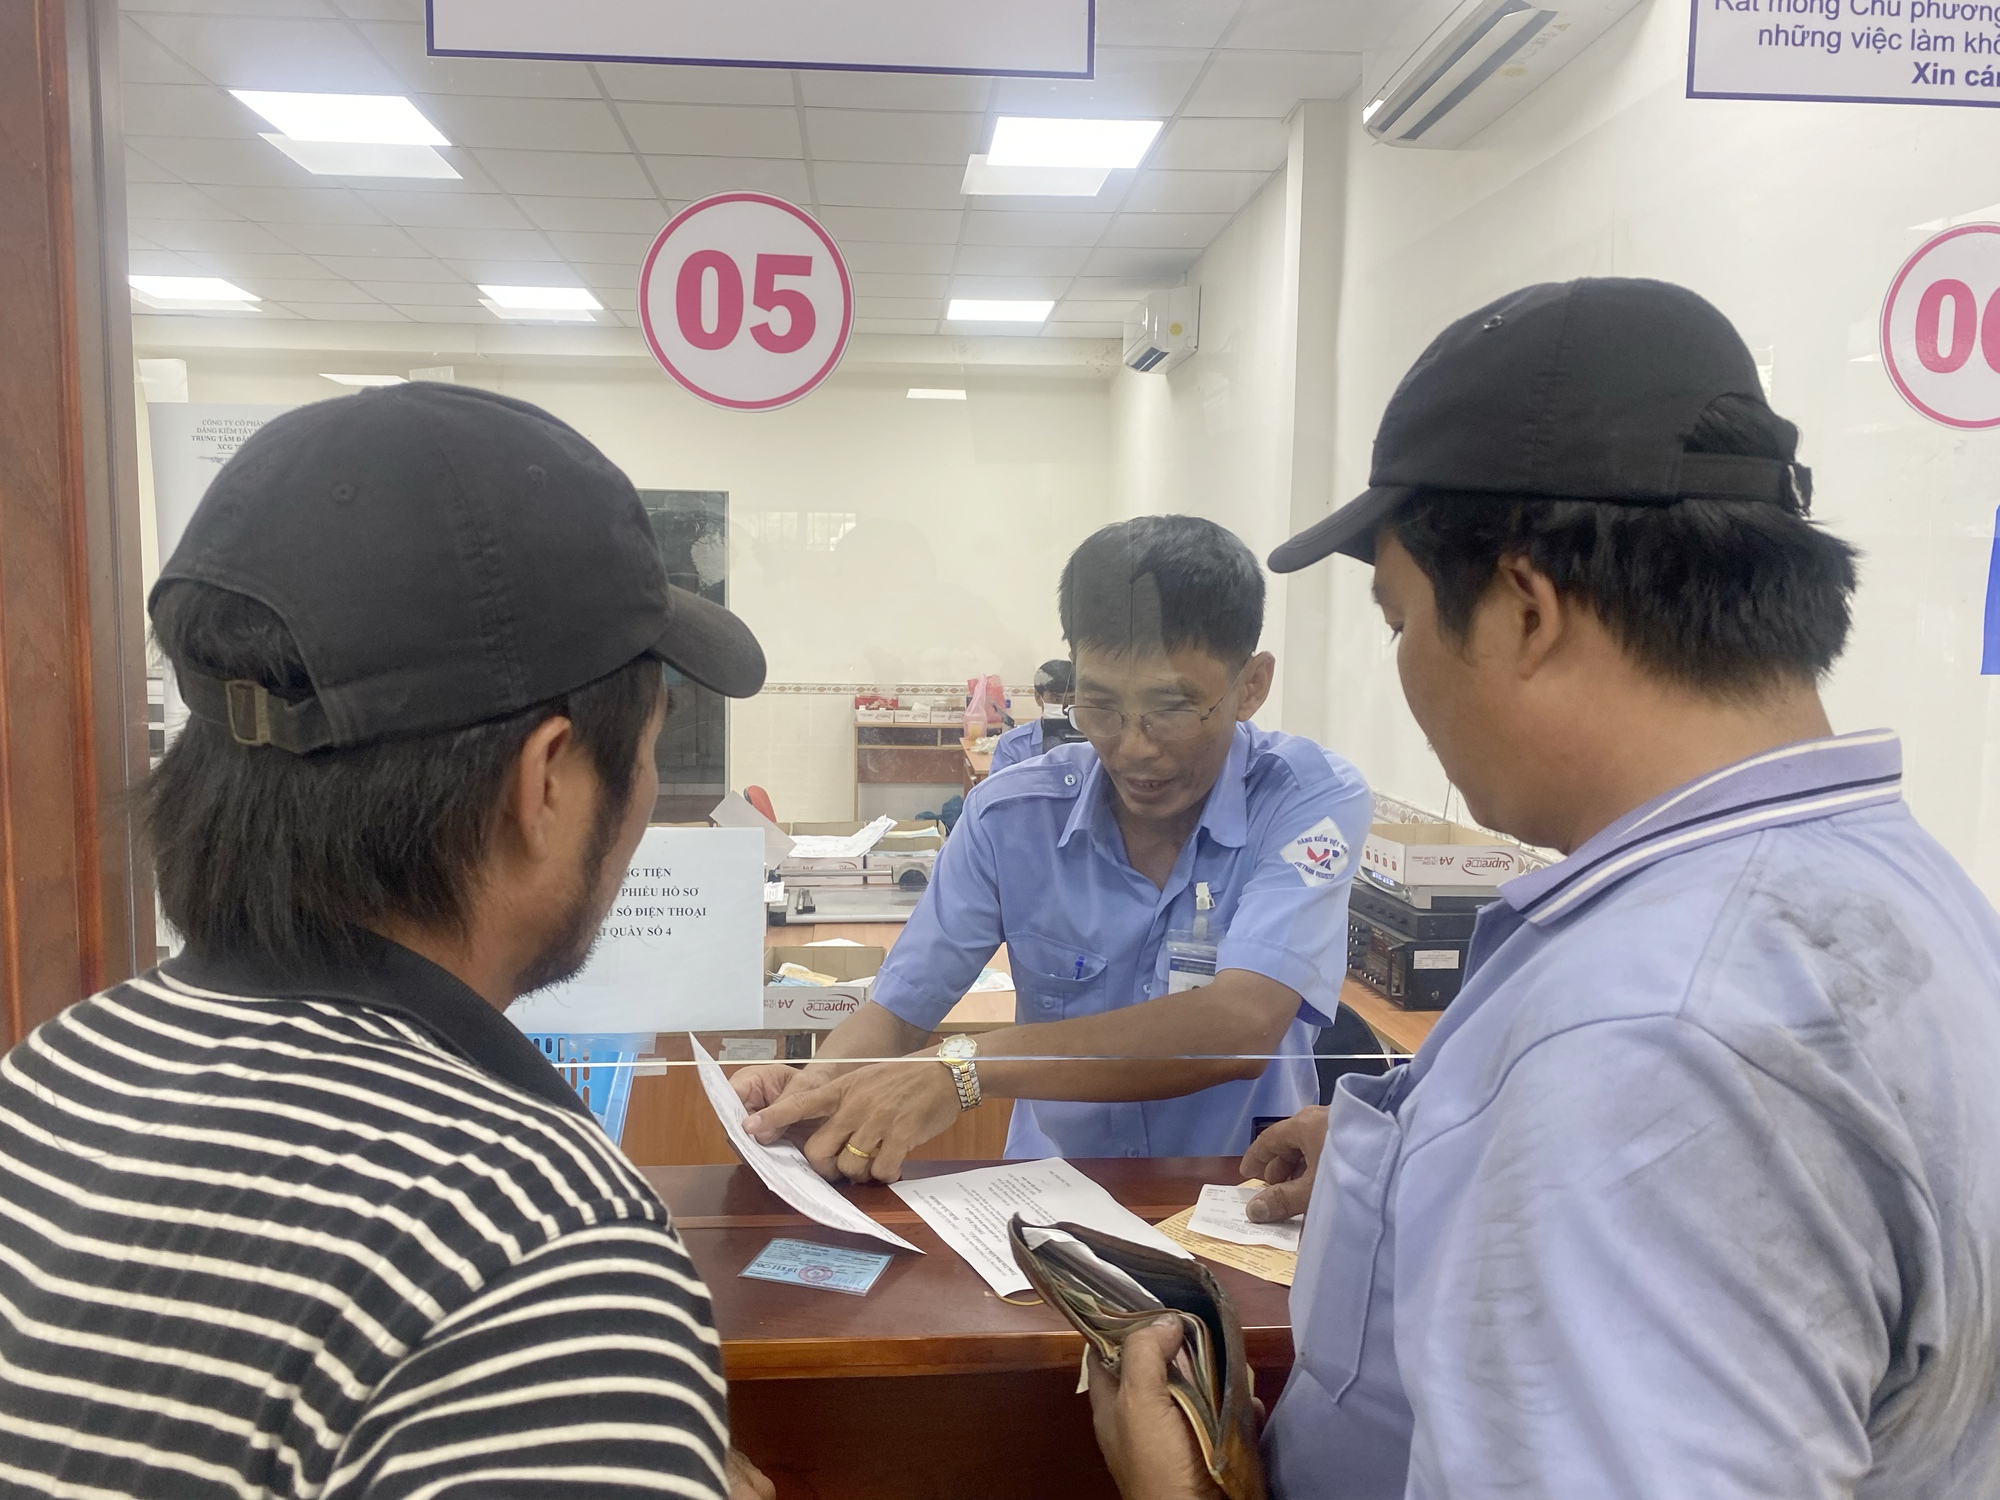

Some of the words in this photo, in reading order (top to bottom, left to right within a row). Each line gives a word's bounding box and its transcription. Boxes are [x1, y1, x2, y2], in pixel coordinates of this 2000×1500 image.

[1758, 23, 1842, 54] những
[1850, 26, 1902, 54] việc
[1910, 28, 1955, 52] làm
[1911, 61, 1956, 85] Xin
[675, 249, 817, 354] 05
[1439, 856, 1454, 866] A4
[642, 866, 672, 880] TIỆN
[622, 884, 658, 897] PHIẾU
[682, 886, 700, 897] SƠ
[616, 905, 632, 917] SỐ
[635, 906, 664, 918] ĐIỆN
[667, 906, 707, 919] THOẠI
[610, 925, 645, 938] QUẦY
[646, 924, 663, 936] SỐ
[665, 927, 672, 936] 4
[778, 999, 794, 1009] A4
